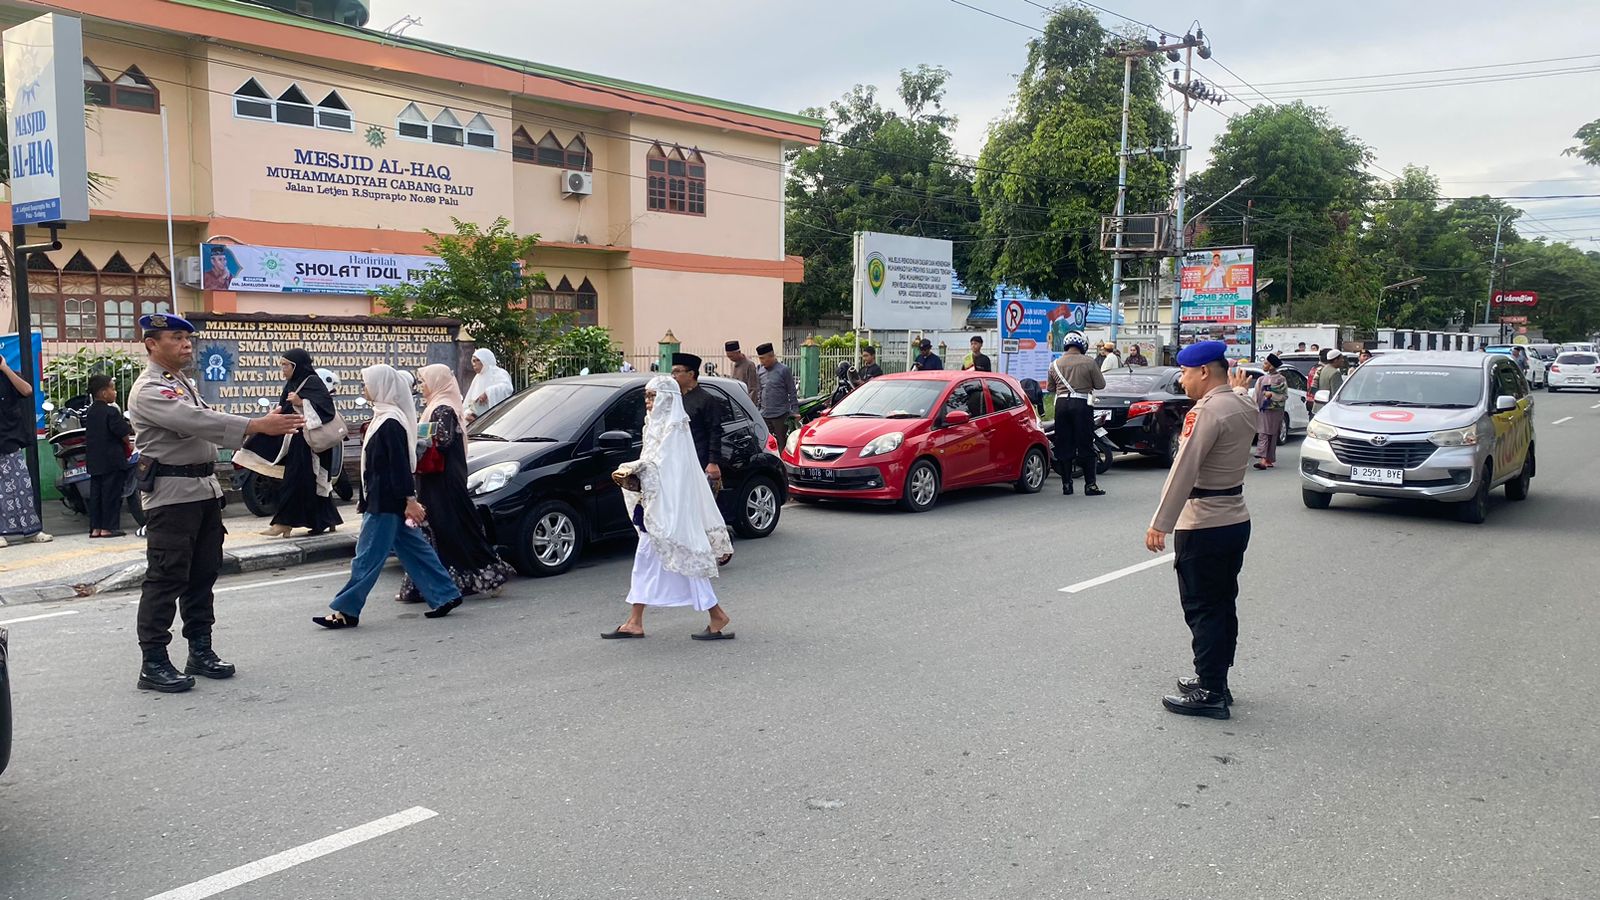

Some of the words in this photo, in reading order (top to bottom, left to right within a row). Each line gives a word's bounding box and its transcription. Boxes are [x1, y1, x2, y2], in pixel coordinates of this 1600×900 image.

[15, 110, 46, 137] MASJID
[13, 139, 54, 178] AL-HAQ
[294, 149, 374, 171] MESJID
[378, 159, 451, 181] AL-HAQ
[266, 166, 387, 188] MUHAMMADIYAH
[390, 179, 441, 194] CABANG
[444, 184, 474, 196] PALU
[285, 182, 314, 193] Jalan
[317, 185, 348, 197] Letjen
[352, 188, 407, 203] R.Suprapto
[409, 194, 436, 204] No.69
[439, 196, 459, 206] Palu
[349, 255, 397, 266] Hadirilah
[295, 263, 361, 278] SHOLAT
[367, 266, 402, 280] IDUL
[1193, 294, 1217, 302] SPMB
[1219, 293, 1240, 301] 2026
[206, 321, 256, 331] MAJELIS
[259, 322, 329, 332] PENDIDIKAN
[331, 324, 365, 333] DASAR
[368, 325, 389, 333] DAN
[392, 326, 448, 335] MENENGAH
[200, 331, 300, 340] MUHAMMADIYAH
[302, 332, 331, 341] KOTA
[334, 332, 360, 341] PALU
[362, 333, 411, 342] SULAWESI
[413, 334, 453, 342] TENGAH
[238, 341, 269, 352] SMA
[272, 341, 386, 353] MUHAMMADIYAH
[389, 343, 395, 353] 1
[397, 343, 428, 353] PALU
[238, 355, 270, 367] SMK
[389, 356, 395, 367] 1
[397, 356, 428, 367] PALU
[234, 371, 263, 381] MTs
[219, 386, 240, 398] MI
[1352, 467, 1358, 476] B
[1362, 468, 1381, 478] 2591
